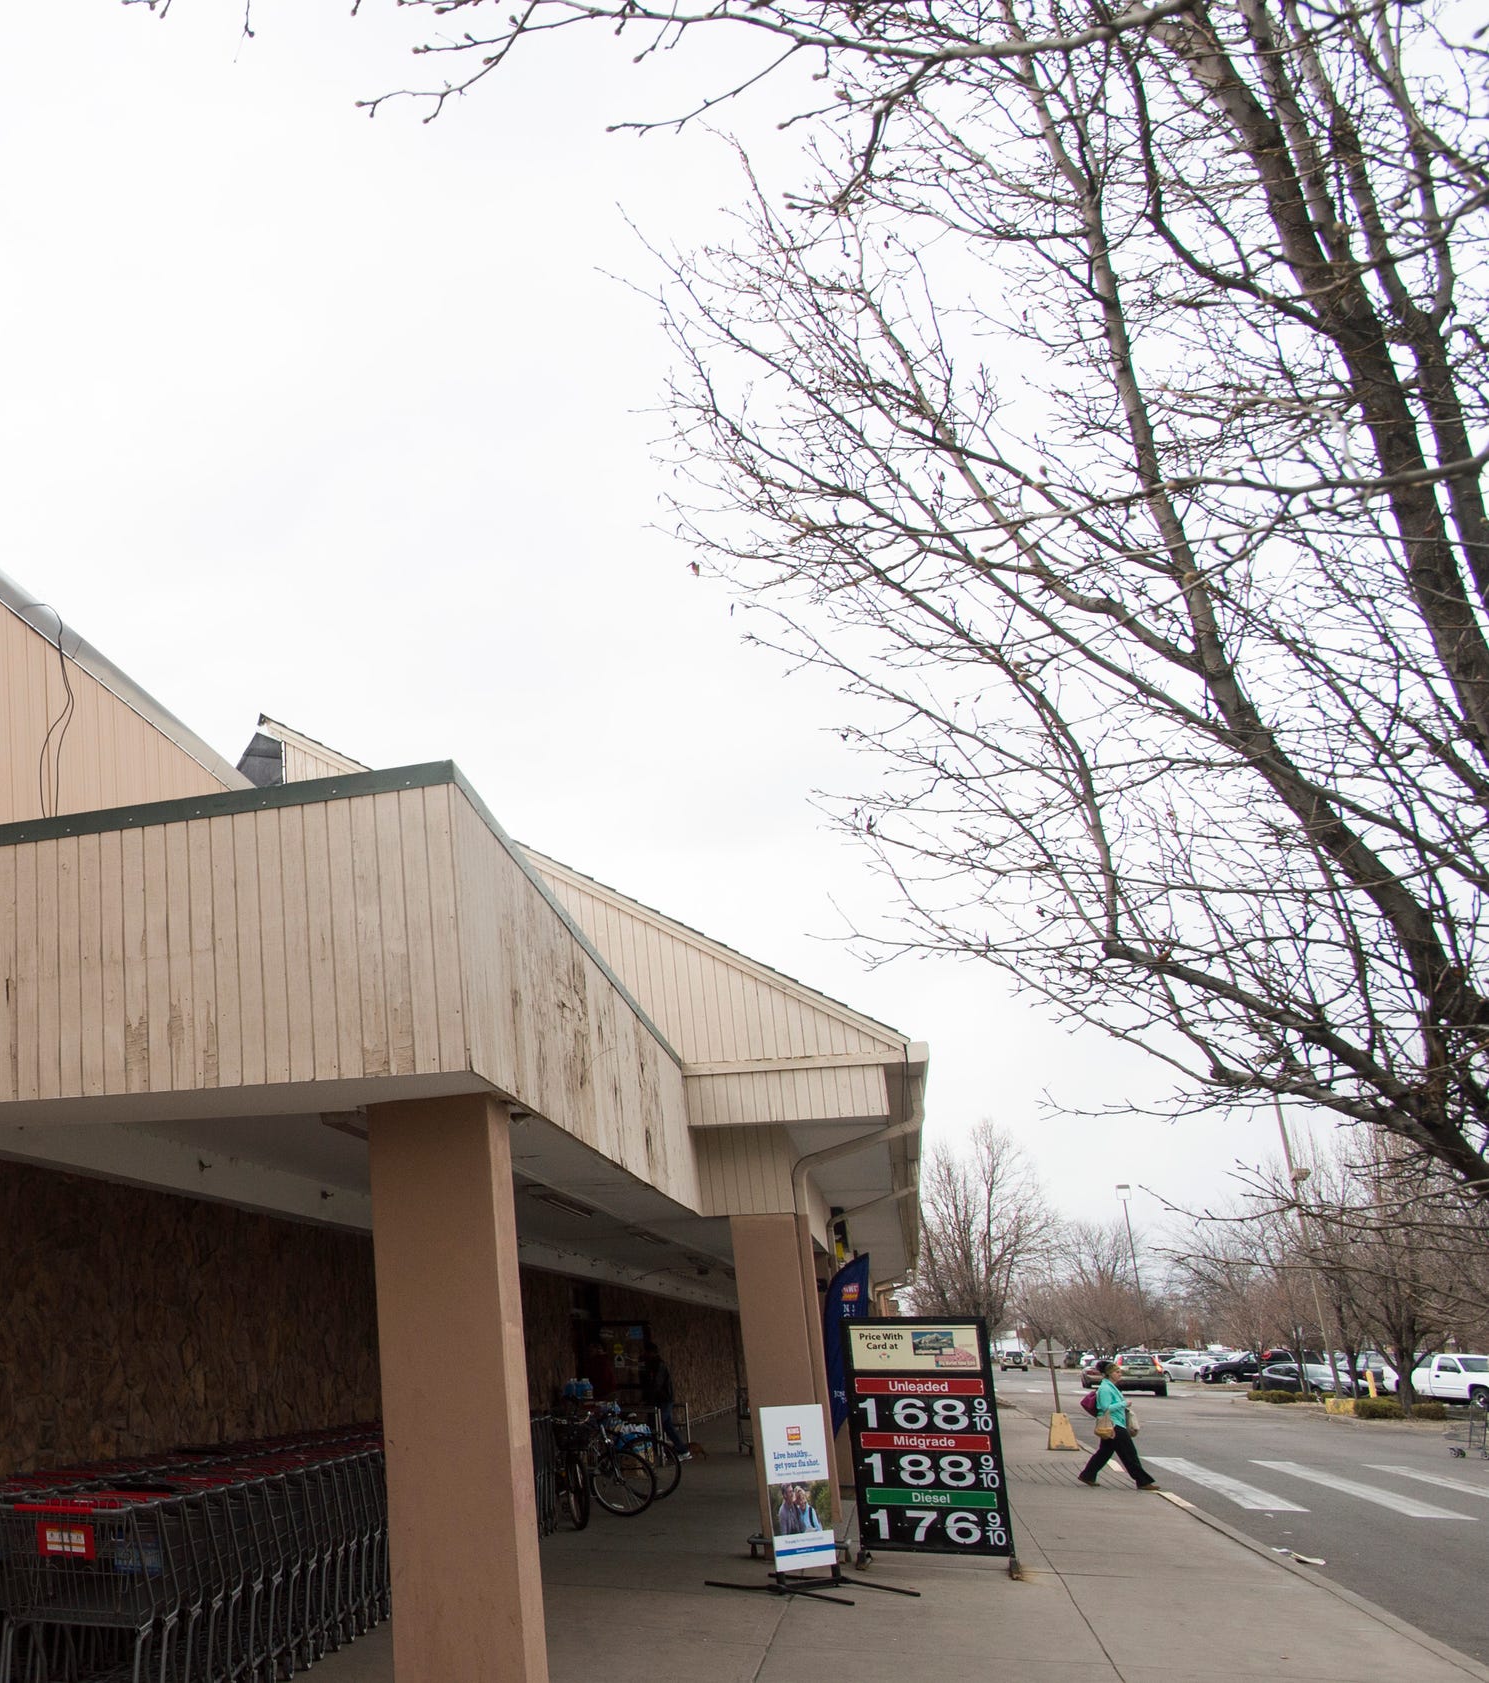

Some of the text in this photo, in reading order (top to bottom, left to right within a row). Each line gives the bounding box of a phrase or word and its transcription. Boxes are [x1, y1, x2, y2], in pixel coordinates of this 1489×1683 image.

[859, 1332, 904, 1342] Price With
[866, 1342, 898, 1351] Card at
[888, 1380, 949, 1393] Unleaded
[858, 1398, 969, 1431] 168
[893, 1436, 956, 1449] Midgrade
[773, 1451, 786, 1460] Live
[774, 1462, 784, 1472] get
[784, 1461, 798, 1471] your
[864, 1453, 976, 1487] 188
[911, 1492, 951, 1504] Diesel
[870, 1508, 982, 1545] 176
